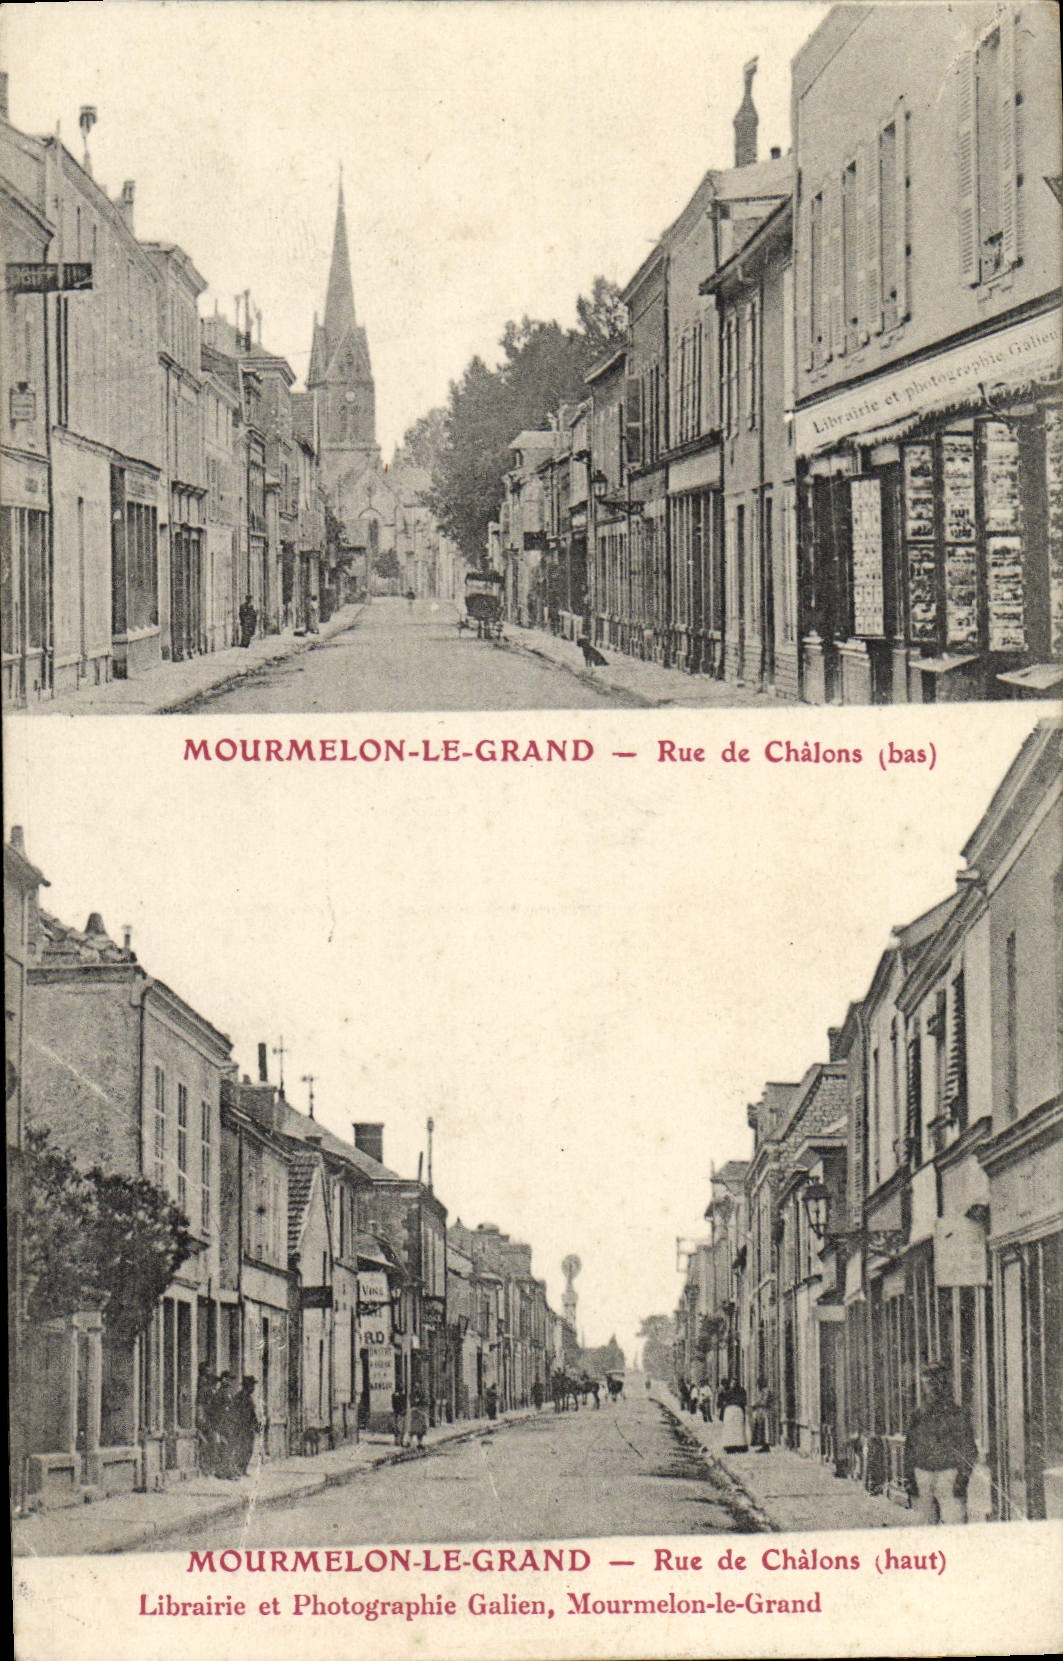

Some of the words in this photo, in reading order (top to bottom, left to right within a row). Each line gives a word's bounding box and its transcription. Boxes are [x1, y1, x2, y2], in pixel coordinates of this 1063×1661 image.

[812, 399, 879, 434] Librairie
[885, 391, 900, 406] et
[905, 351, 1003, 399] photographie
[1008, 328, 1058, 356] Galien
